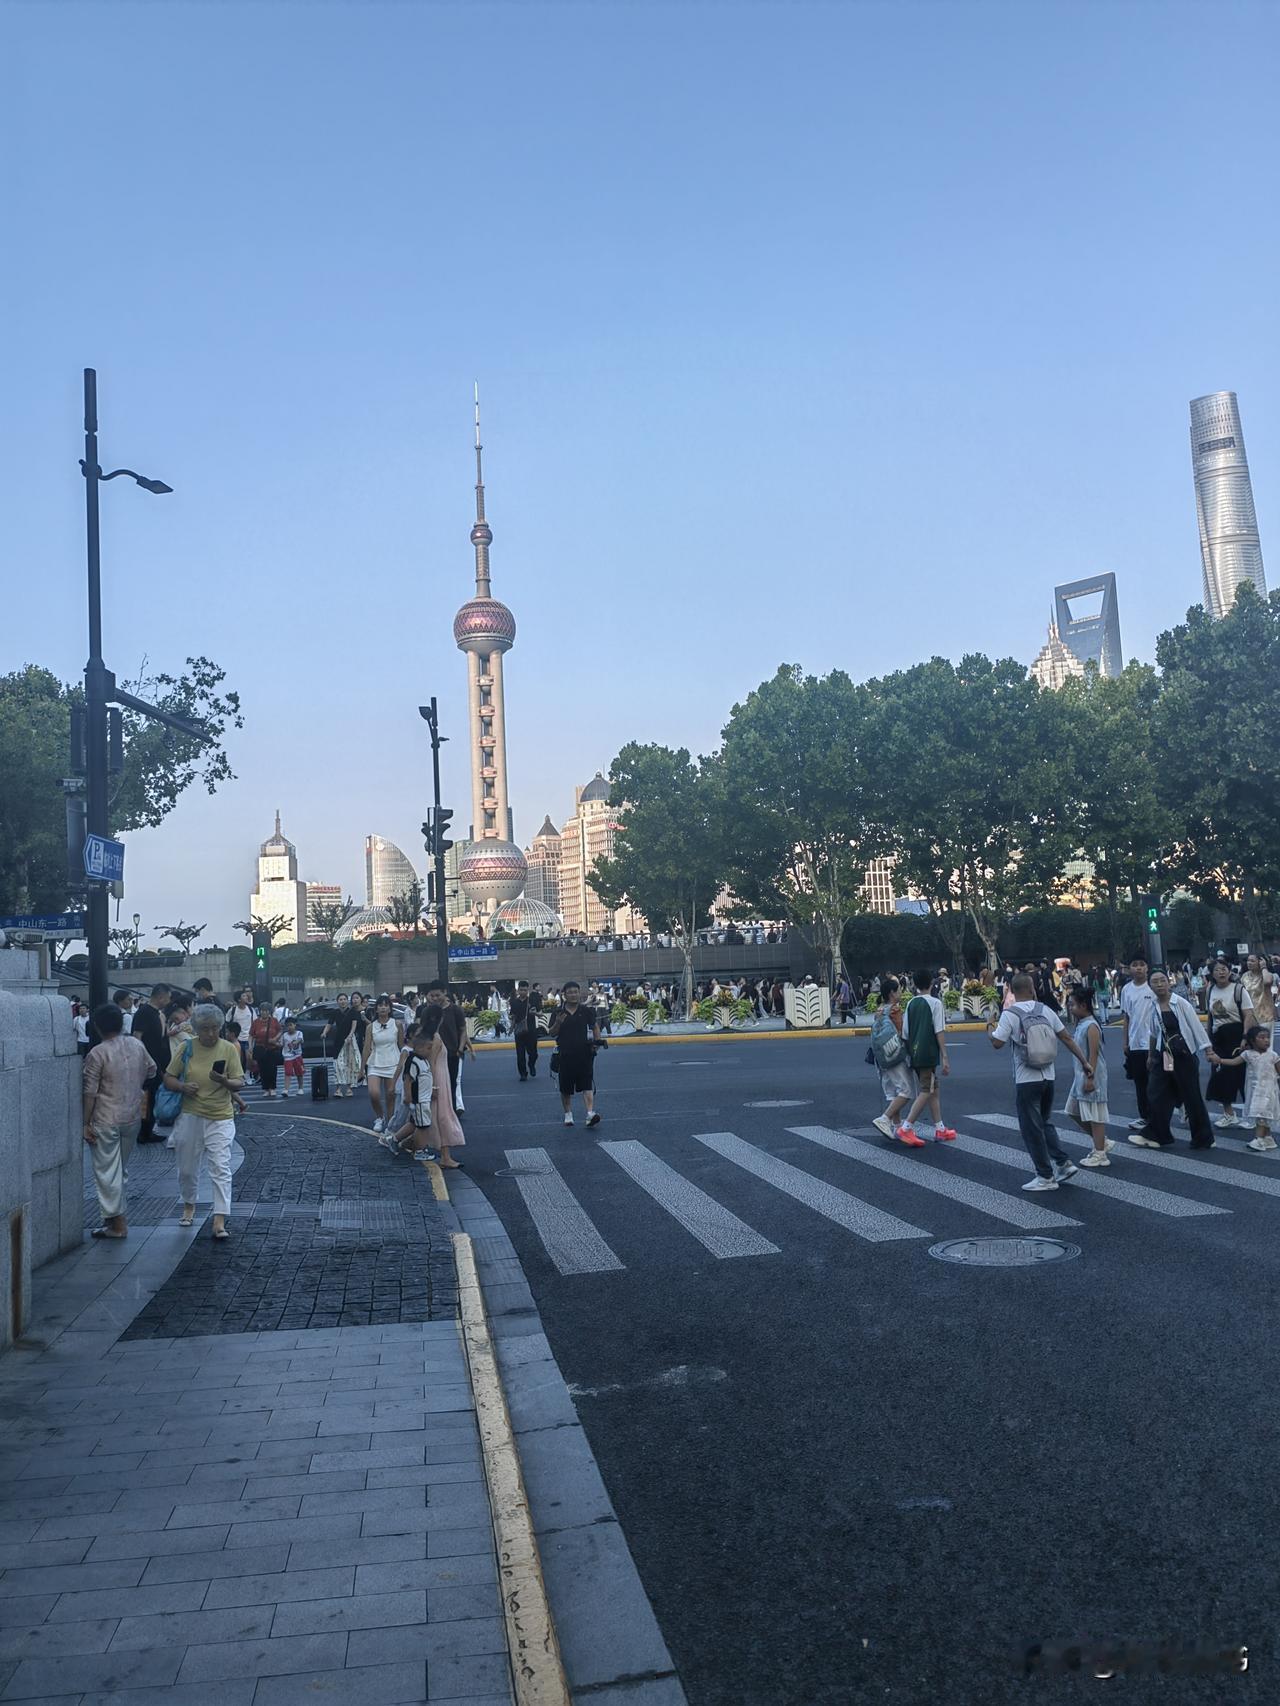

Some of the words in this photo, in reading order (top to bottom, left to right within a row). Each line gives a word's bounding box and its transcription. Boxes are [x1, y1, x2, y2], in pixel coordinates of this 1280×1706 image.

[19, 917, 67, 928] 中山东一路
[457, 948, 488, 956] 中山东一路
